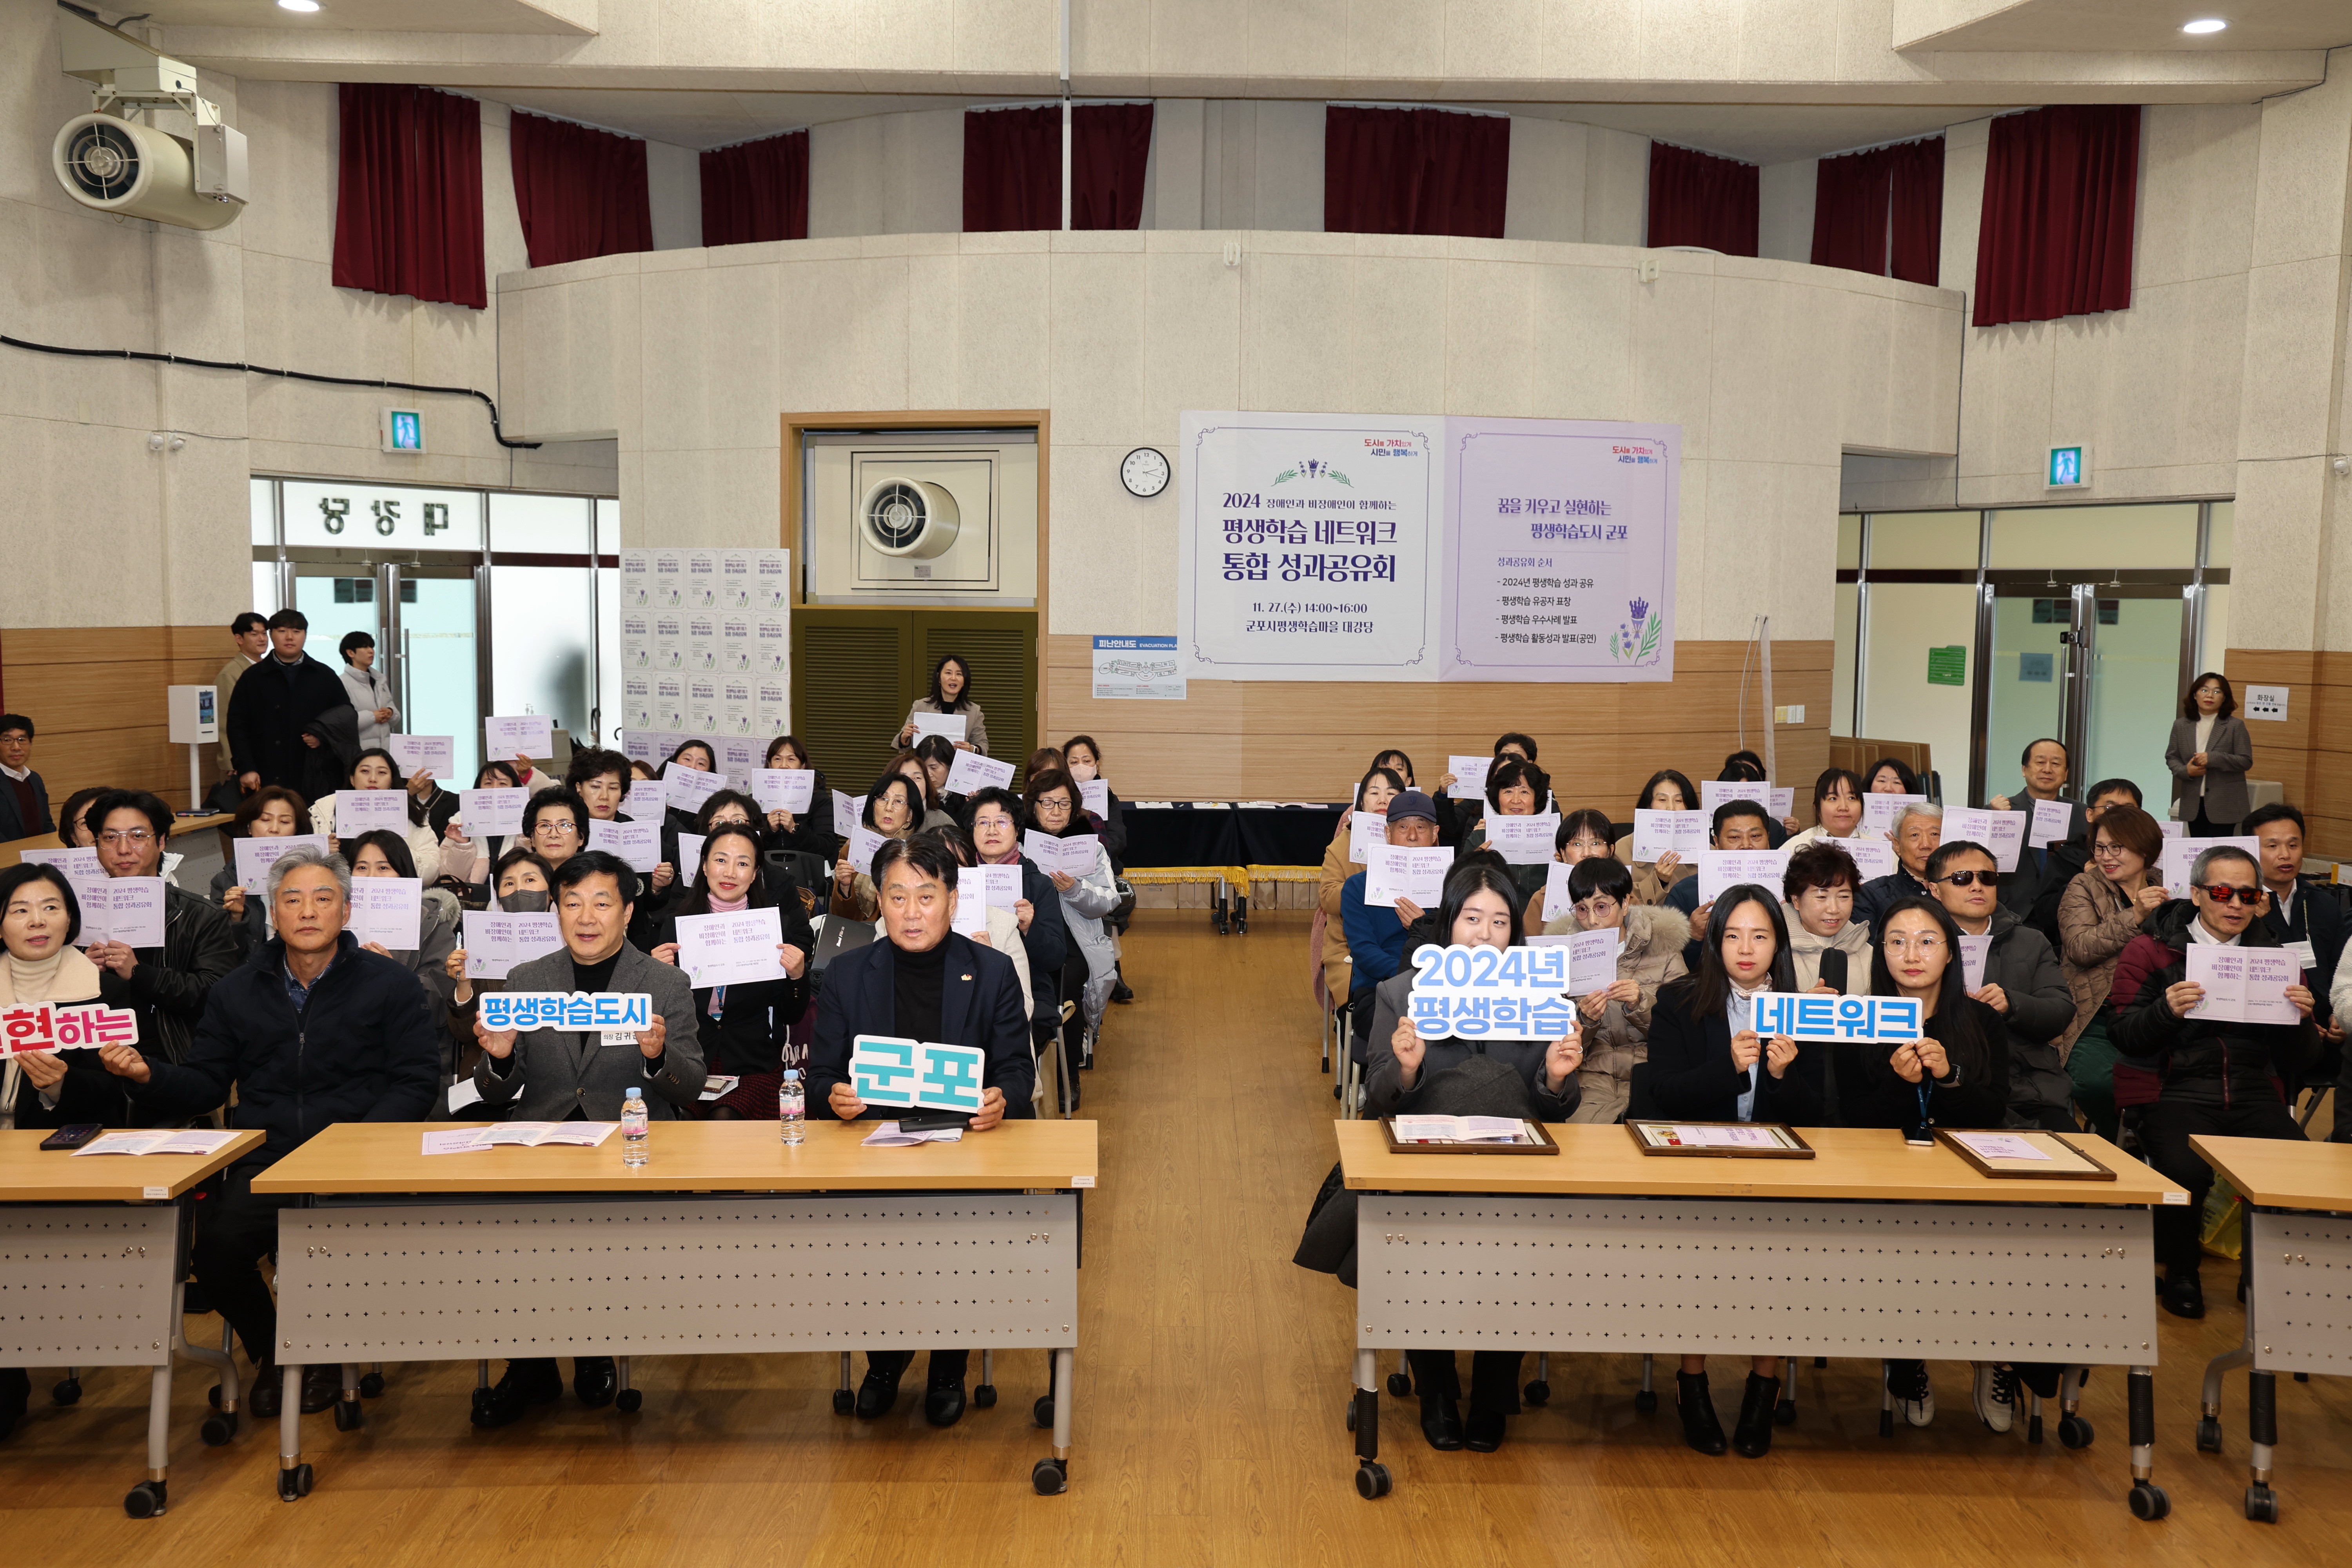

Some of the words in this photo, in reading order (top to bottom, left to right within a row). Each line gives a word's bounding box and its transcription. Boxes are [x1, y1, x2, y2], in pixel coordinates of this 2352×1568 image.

[1223, 493, 1261, 508] 2024
[1267, 499, 1305, 509] 장애인과
[1308, 499, 1355, 510] 비장애인이
[1359, 499, 1397, 510] 함께하는
[1498, 498, 1521, 514] 꿈을
[1525, 499, 1561, 514] 키우고
[1564, 499, 1612, 516] 실현하는
[1223, 518, 1307, 544] 평생학습
[1314, 520, 1397, 545] 네트워크
[1531, 523, 1602, 539] 평생학습도시
[1606, 525, 1628, 540] 군포
[1222, 552, 1270, 581] 통합
[1278, 553, 1396, 582] 성과공유회
[1497, 557, 1535, 567] 성과공유회
[1538, 558, 1552, 567] 순서
[1503, 578, 1530, 587] 2024년
[1533, 578, 1561, 588] 평생학습
[1563, 579, 1577, 588] 성과
[1579, 579, 1593, 588] 공유
[1252, 603, 1264, 612] 11.
[1269, 602, 1301, 614] 27.(수)
[1305, 603, 1368, 613] 14:00~16:00
[1502, 596, 1531, 606] 평생학습
[1533, 597, 1554, 606] 유공자
[1556, 597, 1571, 606] 표창
[1246, 621, 1339, 633] 군포시평생학습마을
[1343, 621, 1374, 634] 대강당
[1501, 615, 1530, 624] 평생학습
[1532, 615, 1561, 624] 우수사례
[1563, 615, 1577, 624] 발표
[1099, 639, 1136, 648] 피난안내도
[1501, 633, 1529, 643] 평생학습
[1531, 633, 1561, 644] 활동성과
[1562, 633, 1597, 644] 발표(공연)
[745, 934, 770, 942] 성과공유회
[1583, 951, 1606, 960] 성과공유회
[1417, 949, 1564, 988] 2024년
[485, 997, 646, 1026] 평생학습도시
[1414, 996, 1572, 1035] 평생학습
[1757, 997, 1918, 1038] 네트워크
[0, 1007, 132, 1054] 현하는
[855, 1041, 978, 1107] 군포
